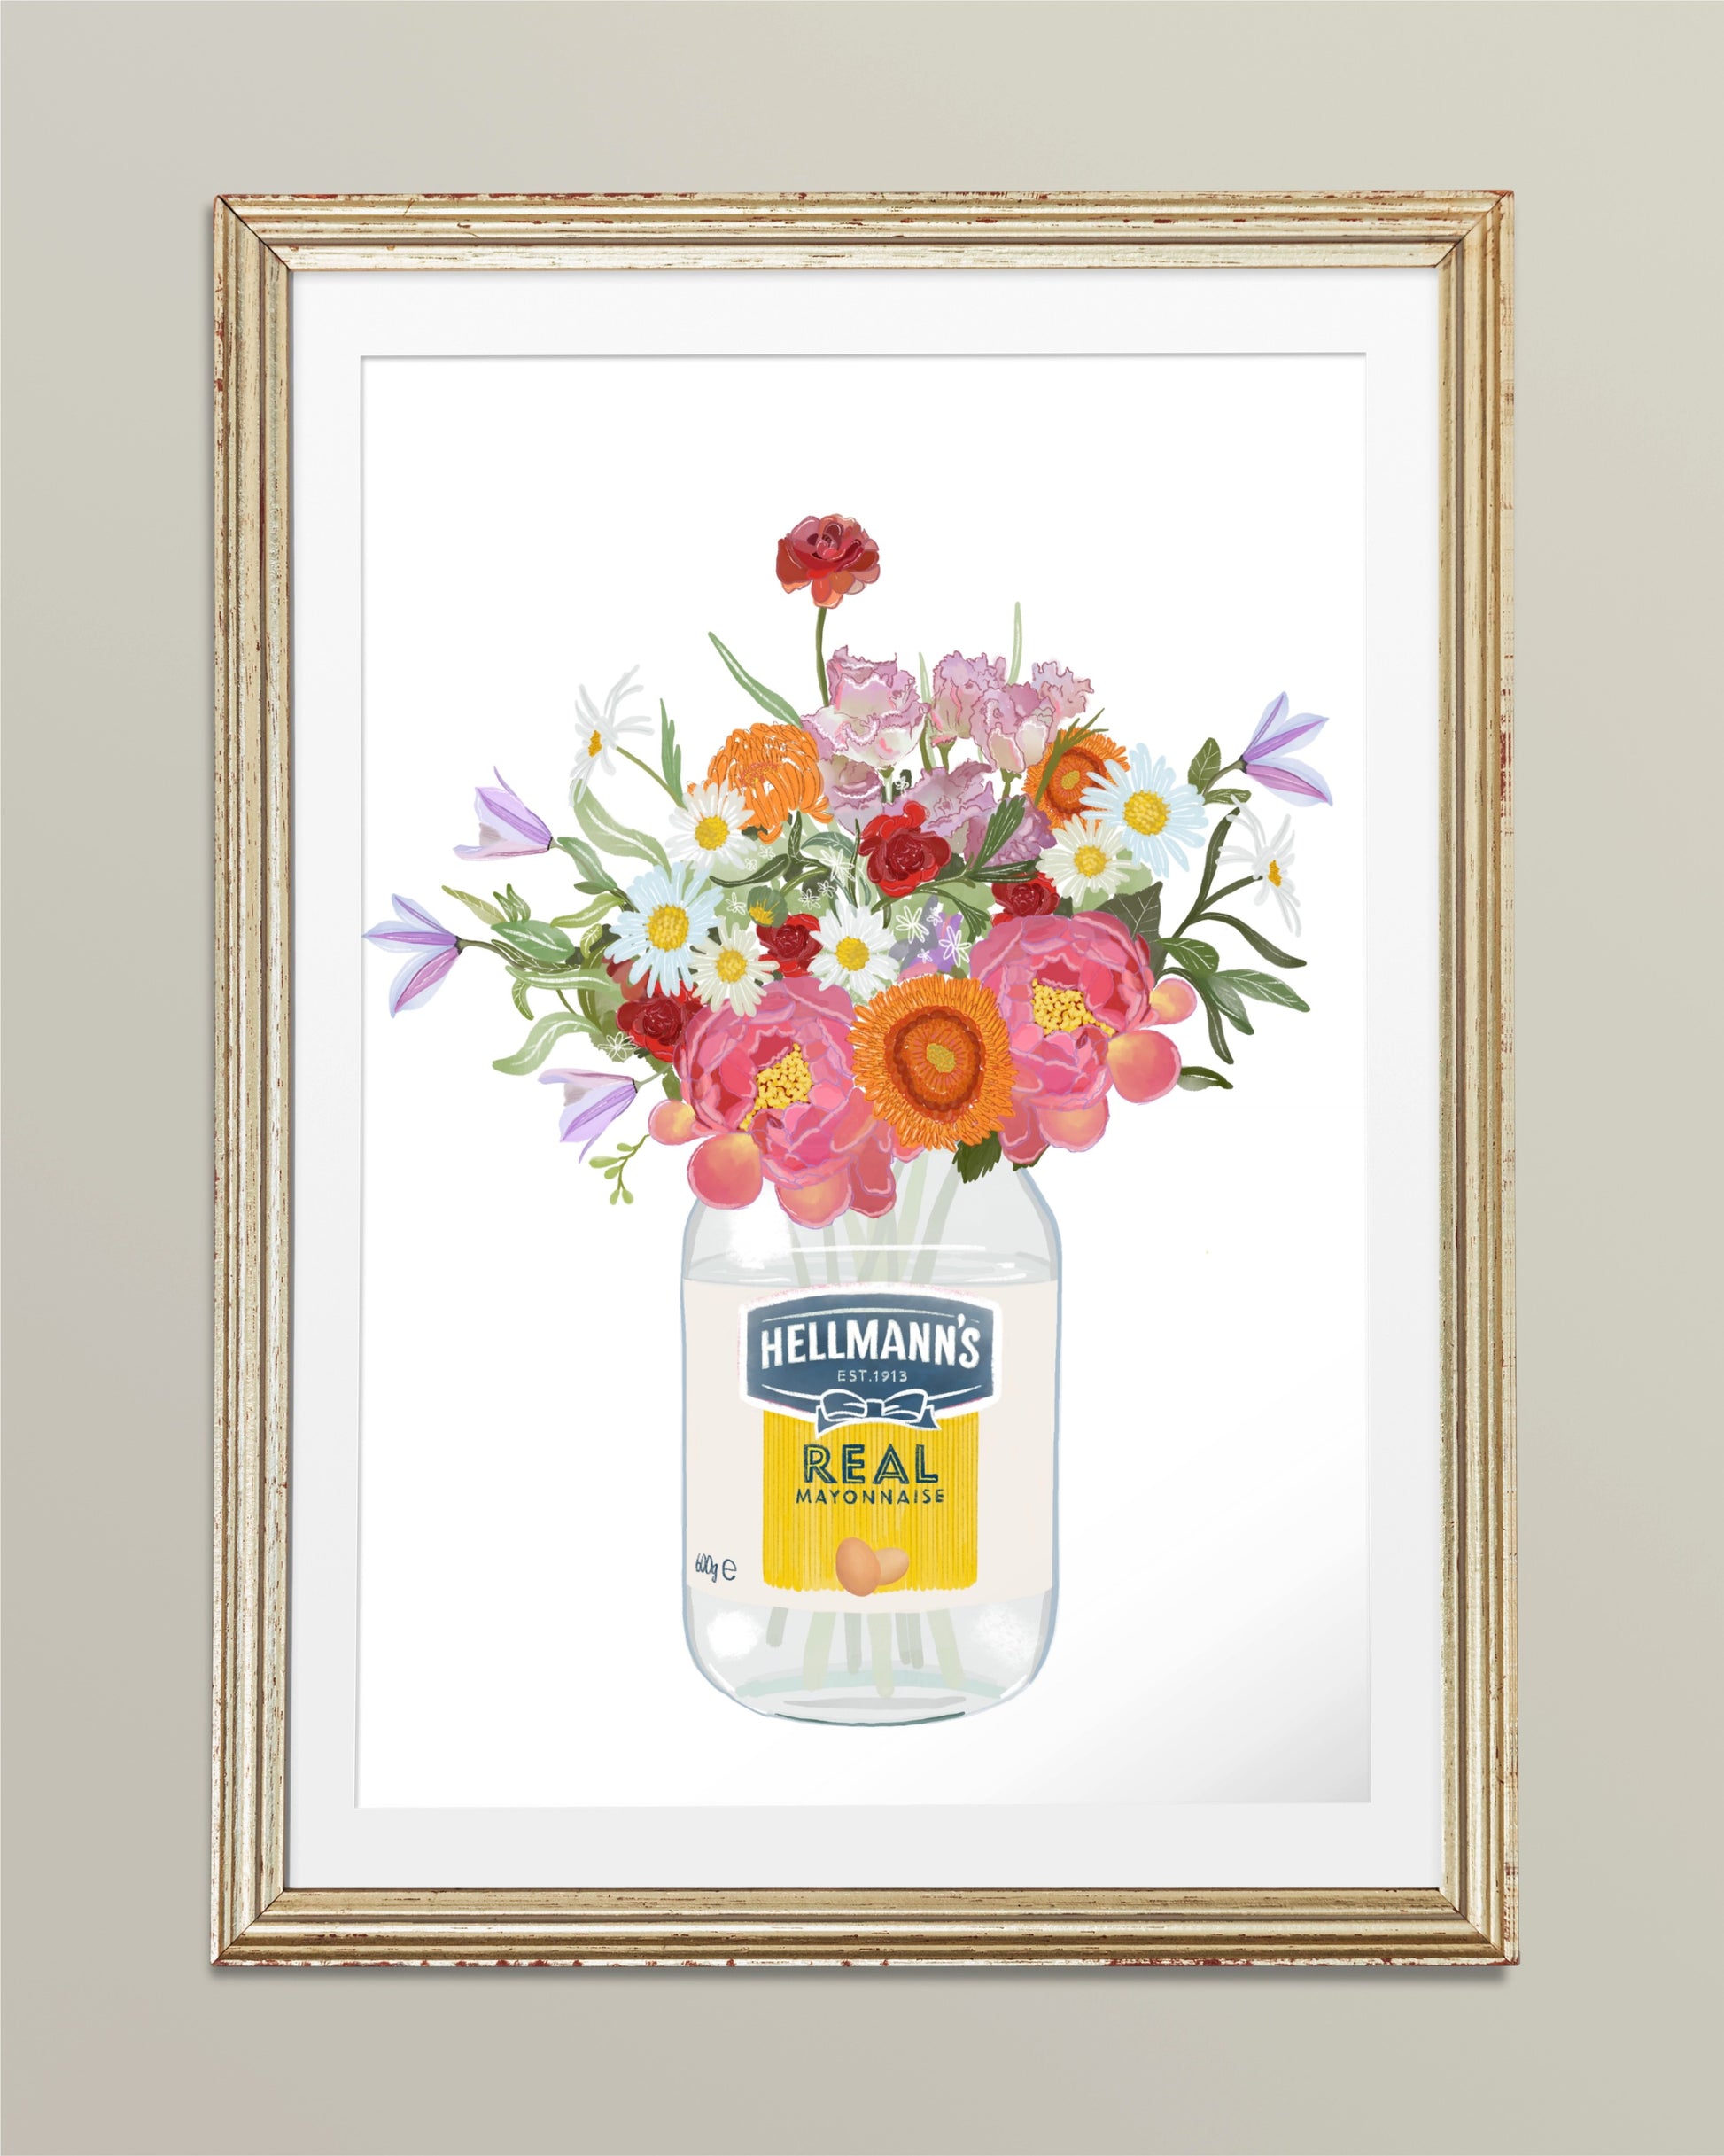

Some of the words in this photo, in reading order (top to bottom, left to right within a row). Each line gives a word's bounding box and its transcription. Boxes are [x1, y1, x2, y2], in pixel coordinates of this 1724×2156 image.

[761, 1313, 981, 1369] HELLMANN'S
[803, 1444, 939, 1484] REAL
[796, 1489, 945, 1505] MAYONNAISE
